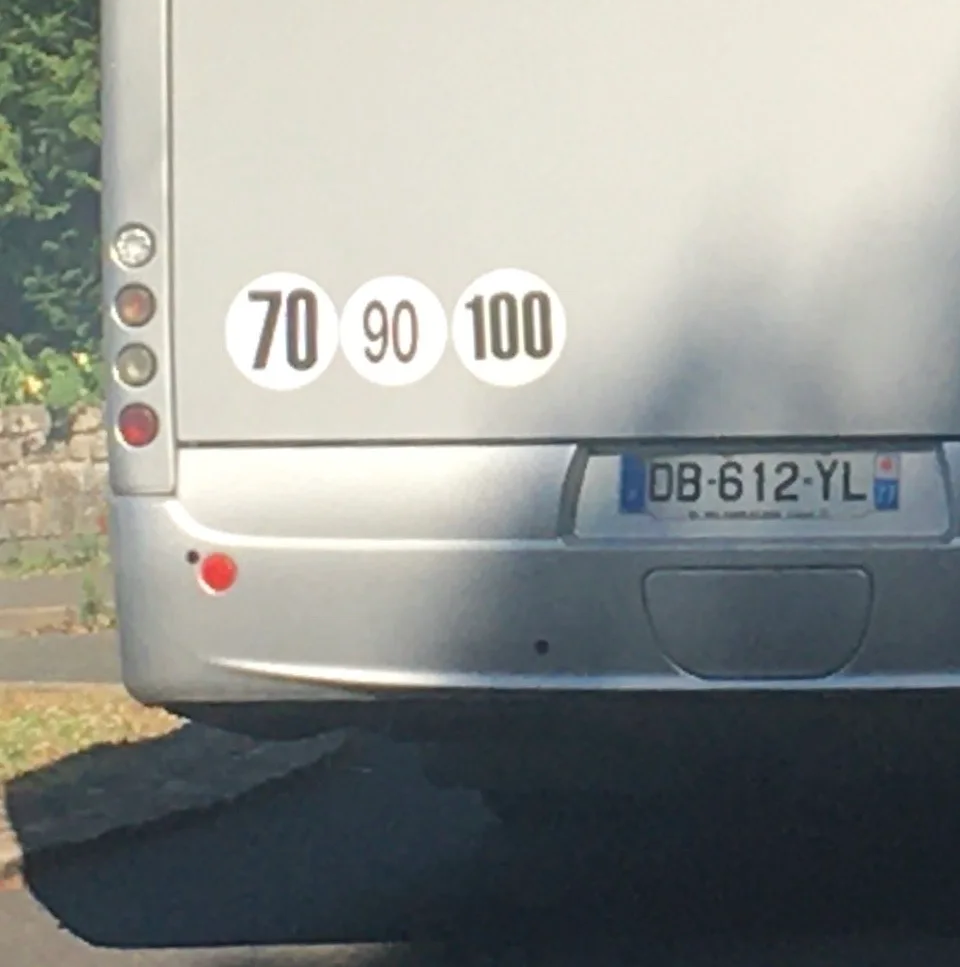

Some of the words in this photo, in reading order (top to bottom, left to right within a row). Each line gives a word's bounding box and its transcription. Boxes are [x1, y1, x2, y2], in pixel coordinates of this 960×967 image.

[248, 288, 318, 371] 70
[363, 299, 419, 364] 90
[465, 290, 553, 360] 100
[650, 459, 868, 503] DB-612-YL
